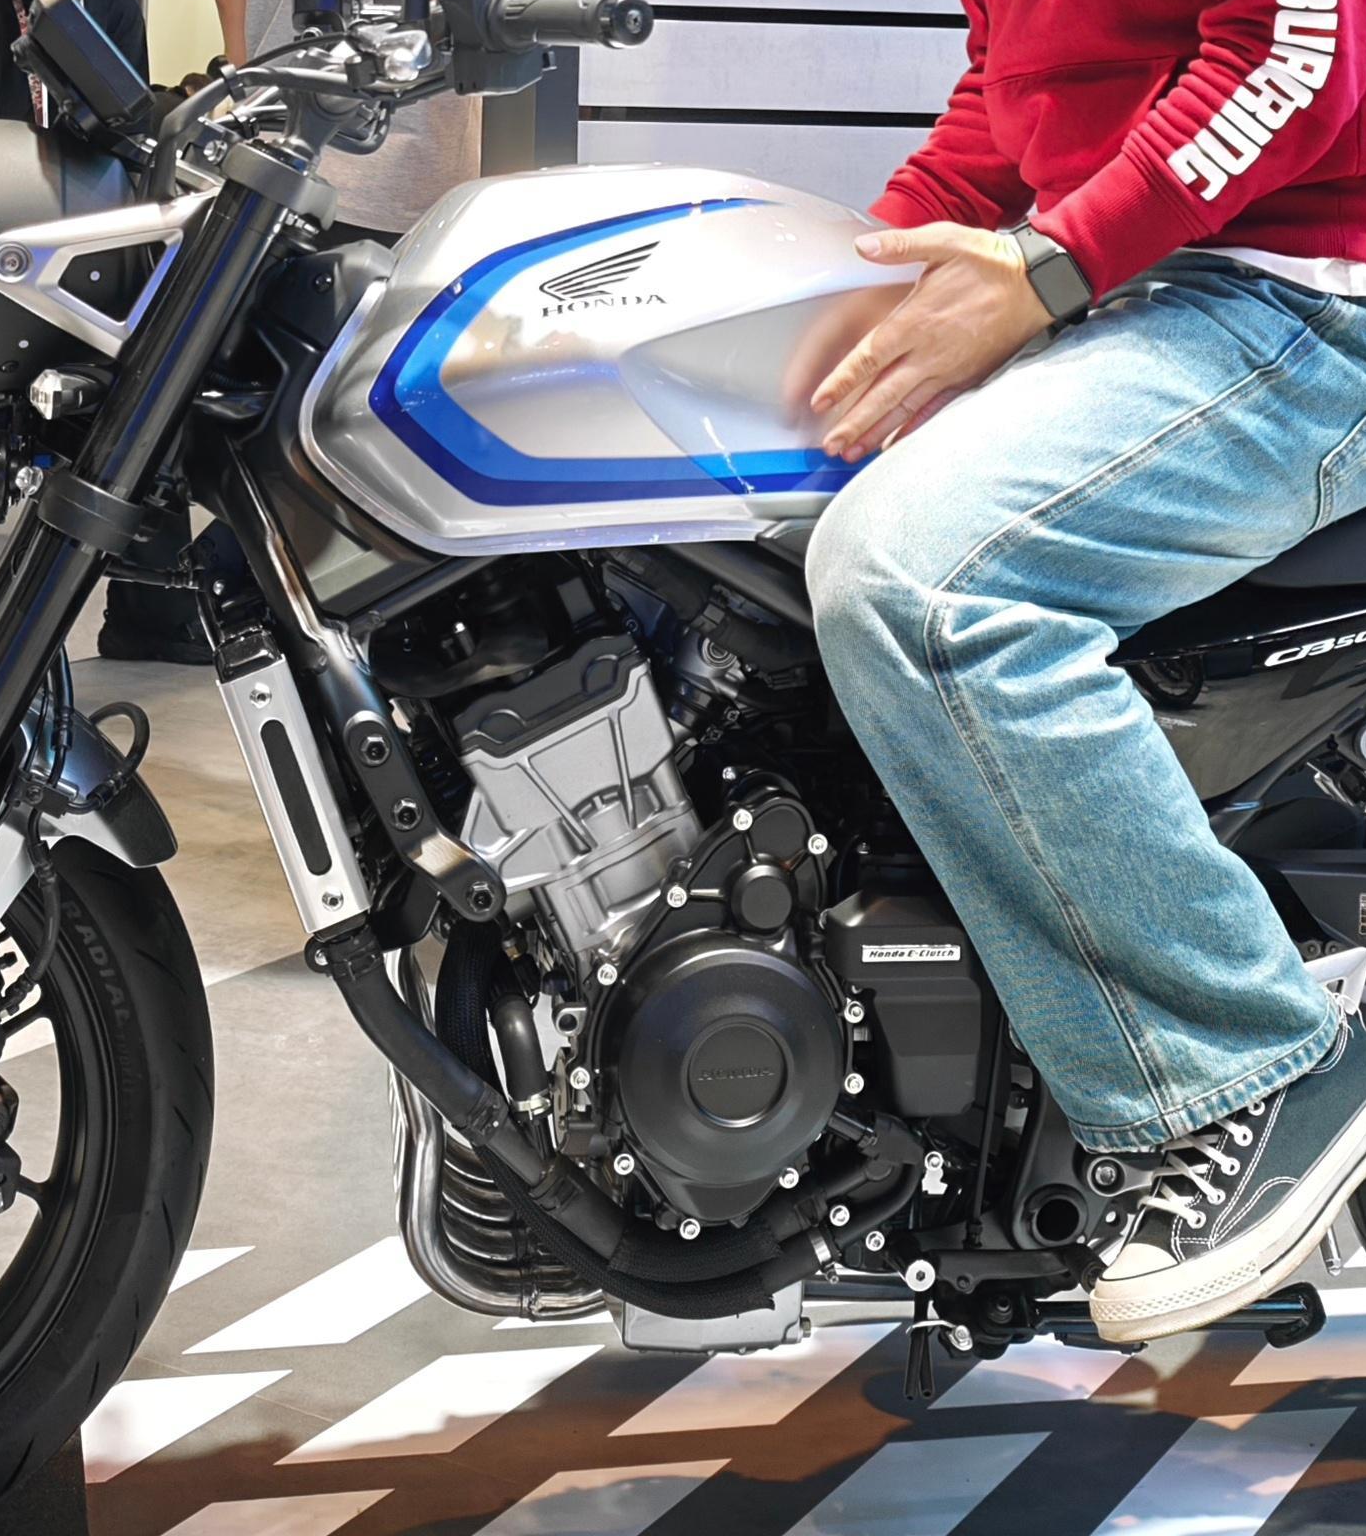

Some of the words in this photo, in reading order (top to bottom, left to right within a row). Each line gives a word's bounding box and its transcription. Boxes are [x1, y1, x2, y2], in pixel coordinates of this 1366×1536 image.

[542, 294, 667, 318] HONDA
[869, 950, 905, 958] Honda
[907, 950, 955, 958] E-Clutch
